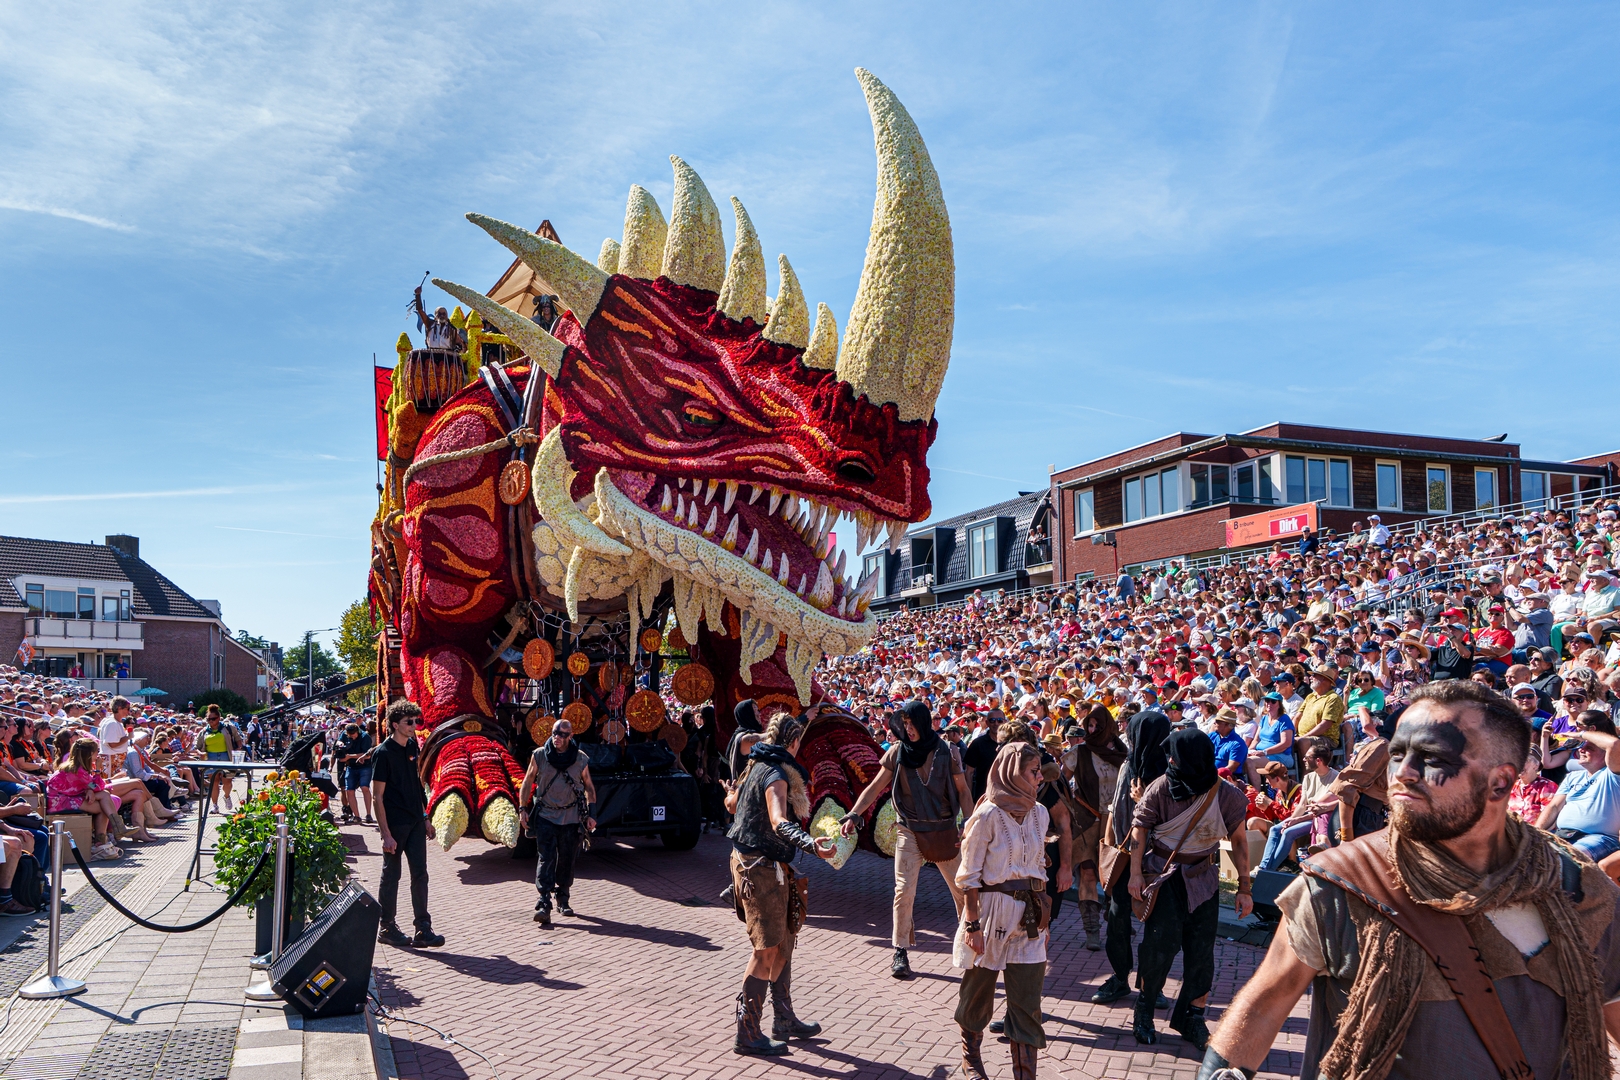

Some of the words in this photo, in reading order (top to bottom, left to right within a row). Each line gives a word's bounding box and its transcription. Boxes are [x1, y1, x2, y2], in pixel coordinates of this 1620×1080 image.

[1233, 521, 1239, 530] B
[1279, 517, 1299, 533] Dirk
[653, 808, 664, 816] 02
